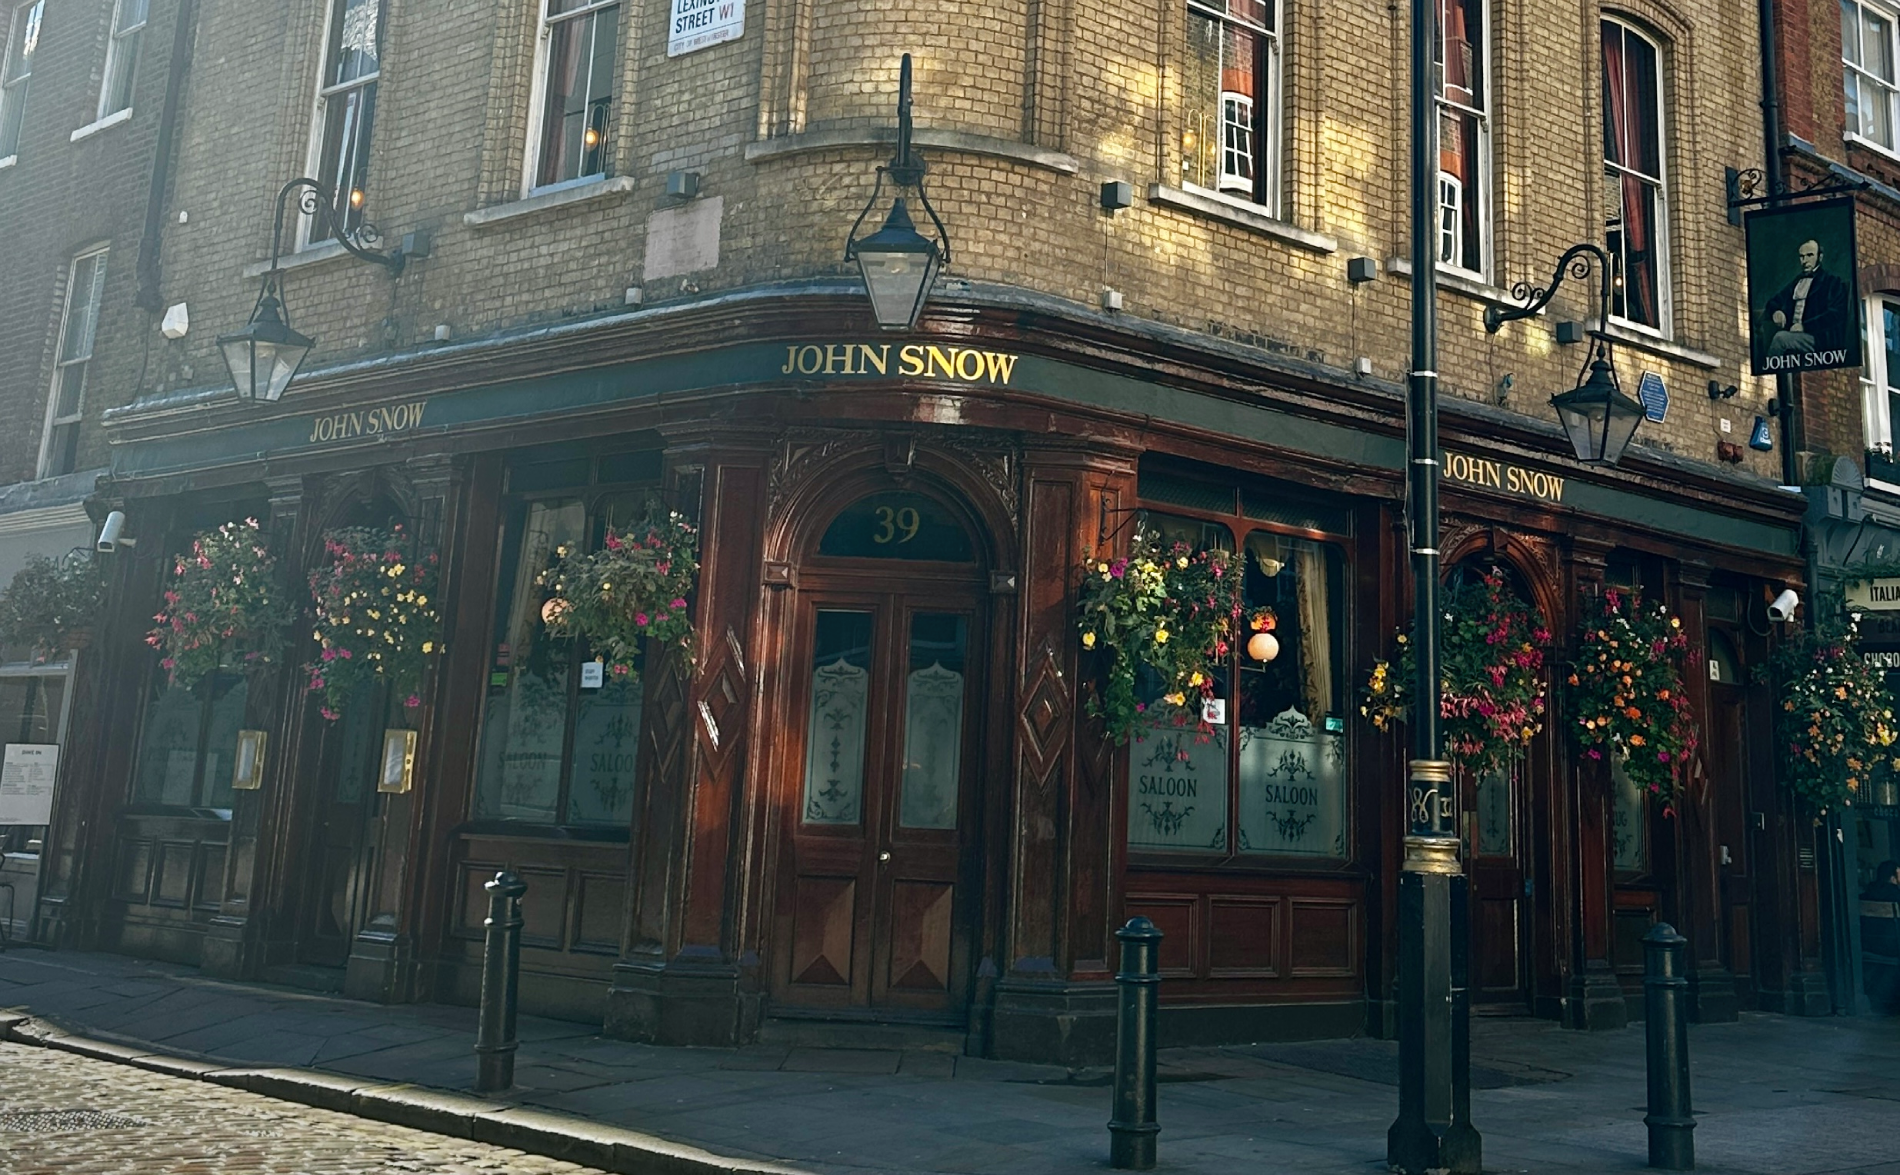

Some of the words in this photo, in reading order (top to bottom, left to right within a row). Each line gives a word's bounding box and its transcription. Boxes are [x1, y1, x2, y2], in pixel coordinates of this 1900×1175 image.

[675, 7, 715, 34] STREET
[719, 2, 734, 21] W1
[781, 343, 892, 375] JOHN
[898, 344, 1019, 385] SNOW
[1762, 353, 1801, 371] JOHN
[1804, 348, 1847, 367] SNOW
[309, 410, 365, 443] JOHN
[365, 401, 428, 435] SNOW
[1443, 451, 1502, 489] JOHN
[1506, 466, 1565, 502] SNOW
[873, 505, 920, 545] 39
[589, 752, 637, 773] SALOO
[1138, 775, 1198, 798] SALOON
[1265, 784, 1318, 806] SALOON
